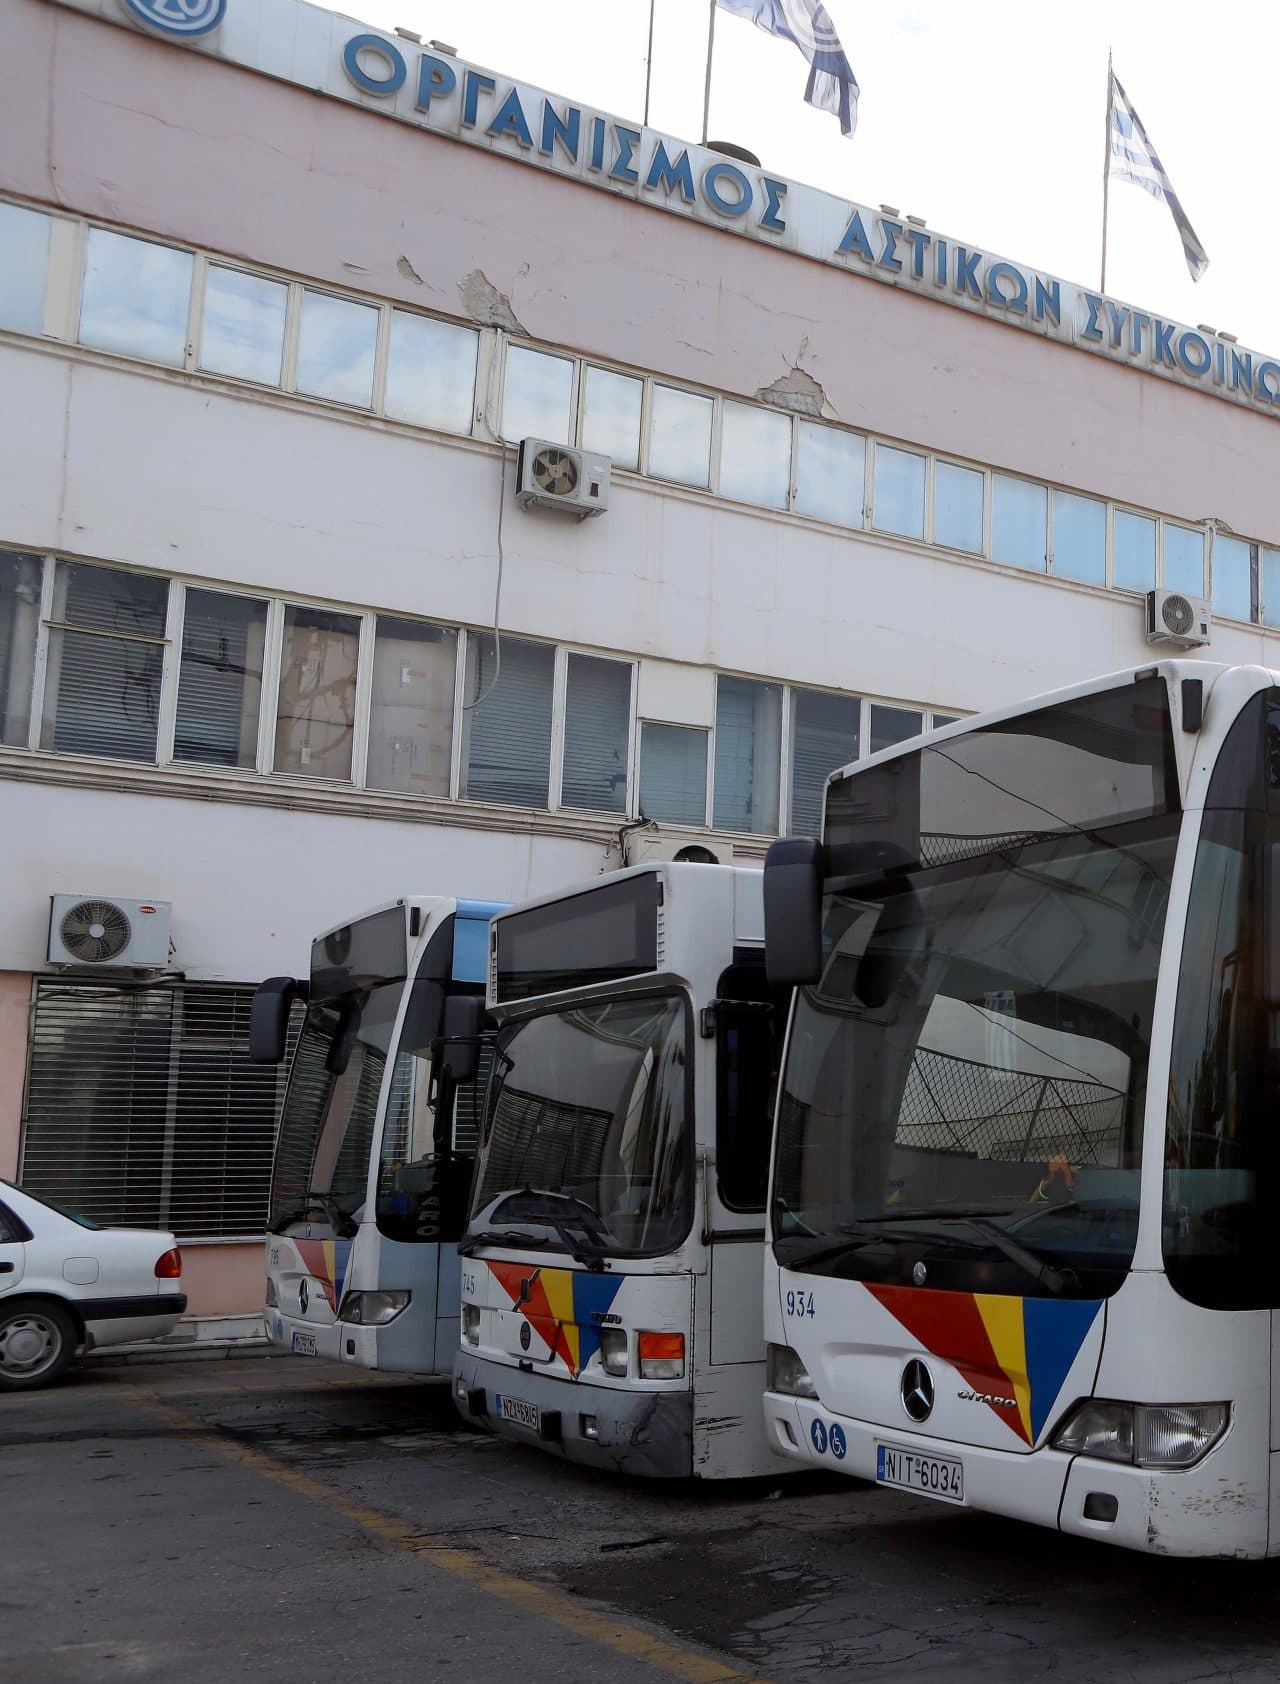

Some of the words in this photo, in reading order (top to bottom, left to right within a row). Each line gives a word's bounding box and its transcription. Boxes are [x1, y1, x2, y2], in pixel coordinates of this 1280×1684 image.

[343, 33, 788, 233] ΟΡΓΑΝΙΣΜΟΣ
[836, 210, 1061, 328] ΑΣΤΙΚΩΝ
[786, 1289, 815, 1319] 934
[957, 1390, 1017, 1408] CITARO
